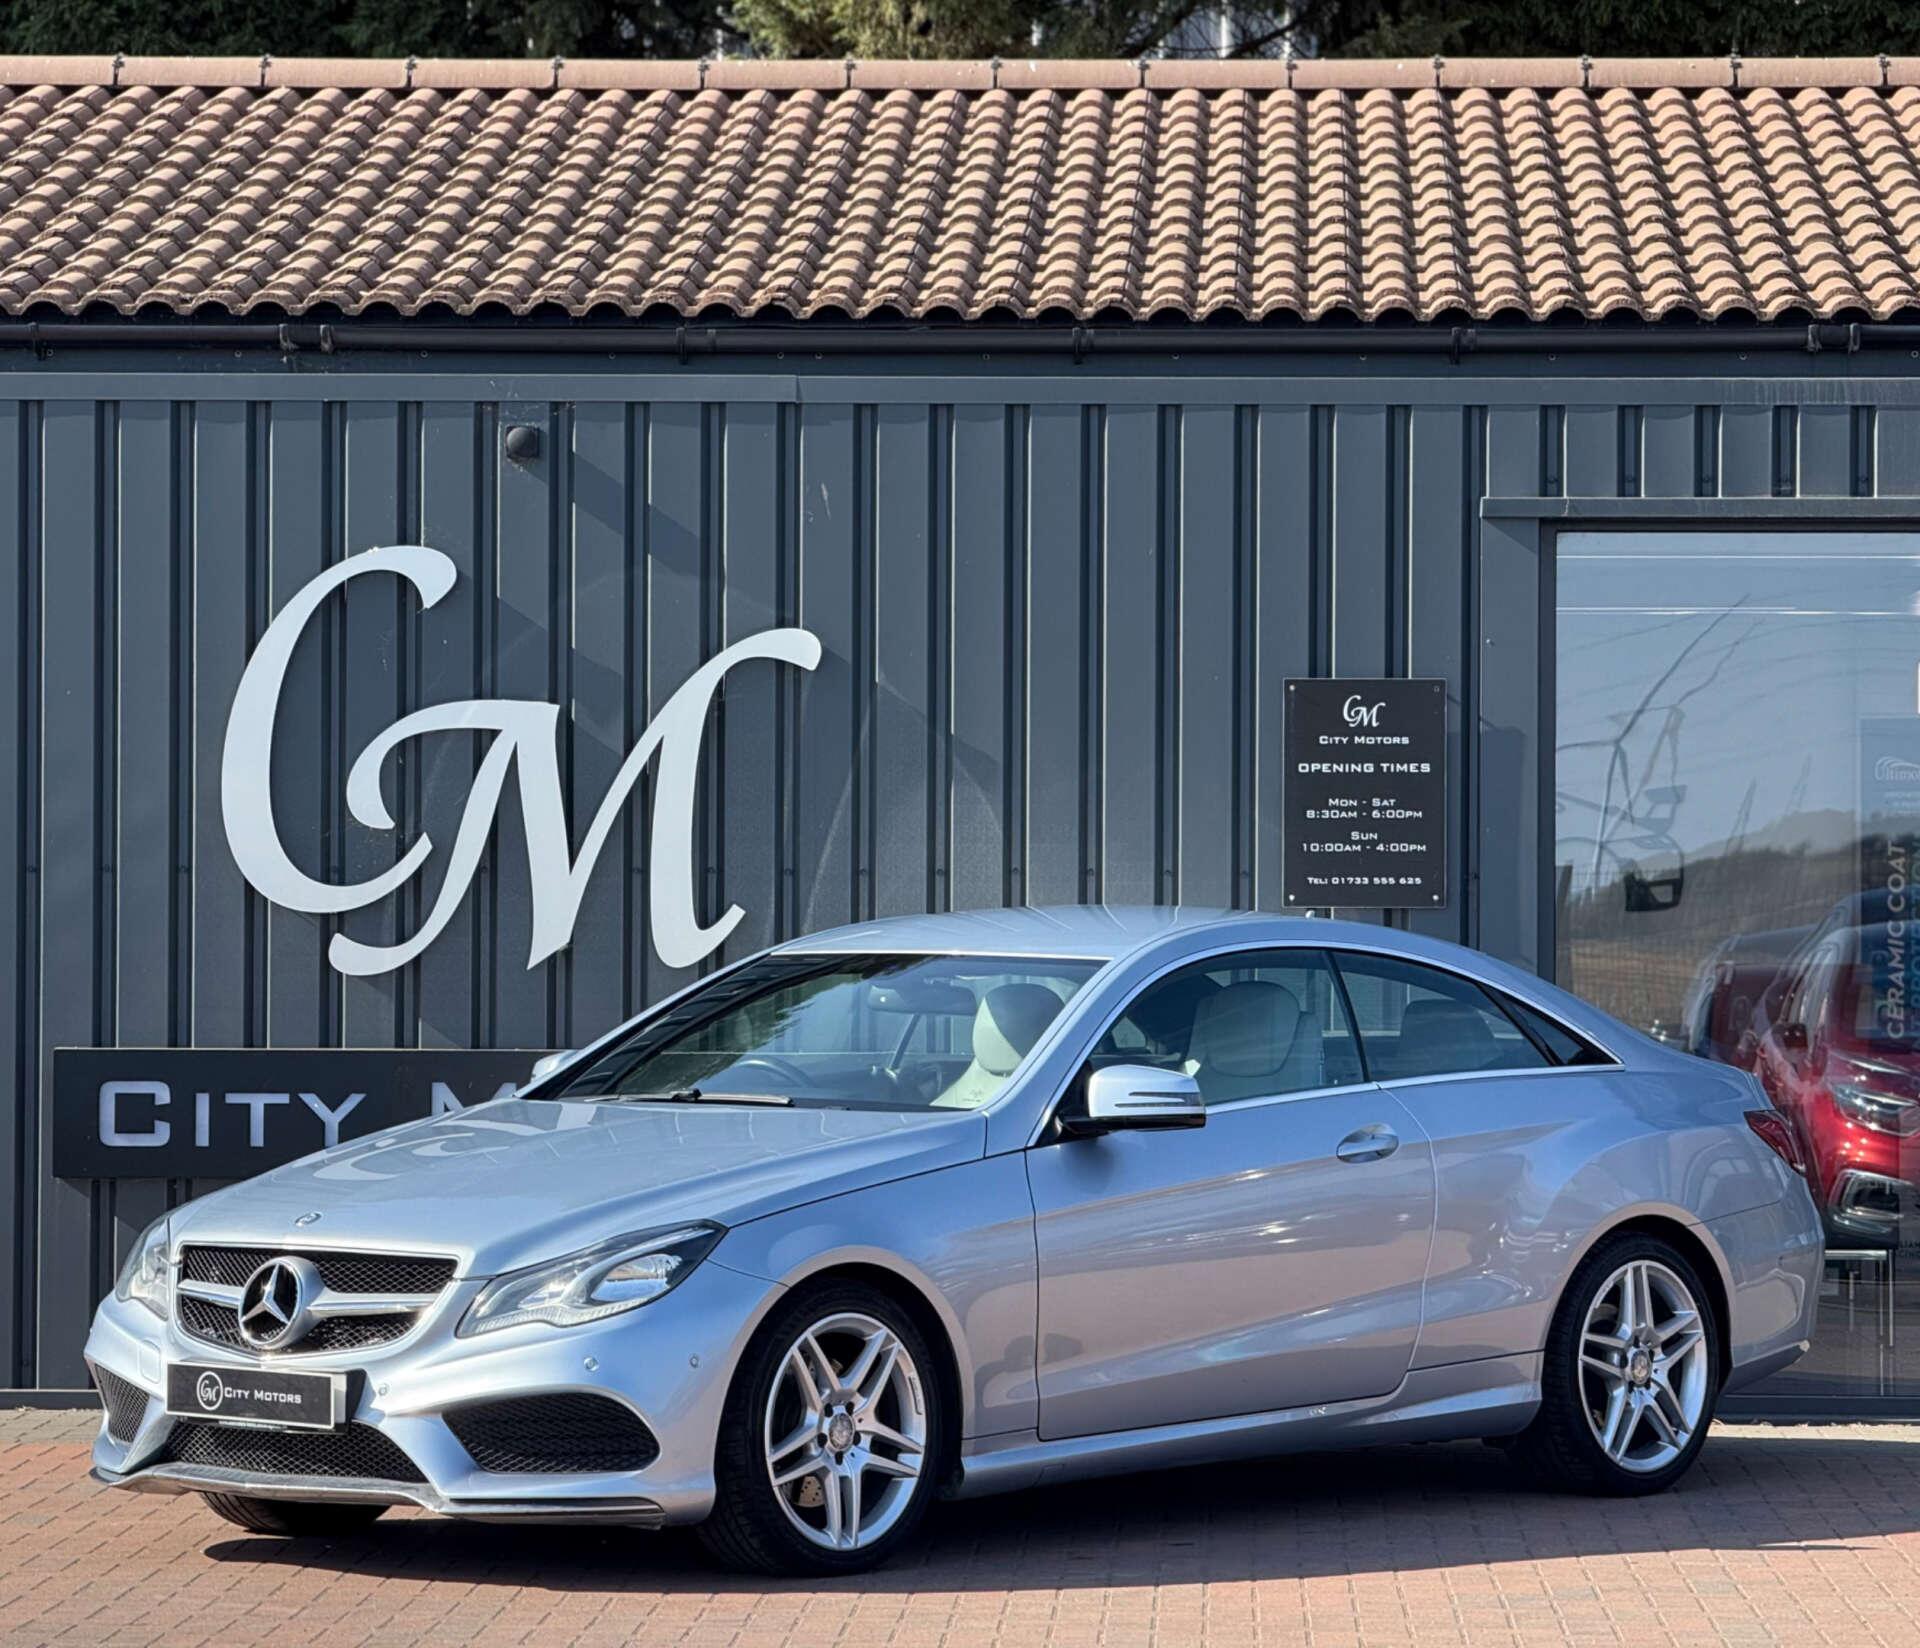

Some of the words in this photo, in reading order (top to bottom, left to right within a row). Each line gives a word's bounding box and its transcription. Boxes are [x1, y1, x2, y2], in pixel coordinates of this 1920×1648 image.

[1298, 762, 1375, 773] OPENING
[1380, 762, 1431, 773] TIMES
[1887, 839, 1905, 913] COAT
[1887, 920, 1905, 1039] CERAMIC
[99, 1081, 366, 1148] CITY
